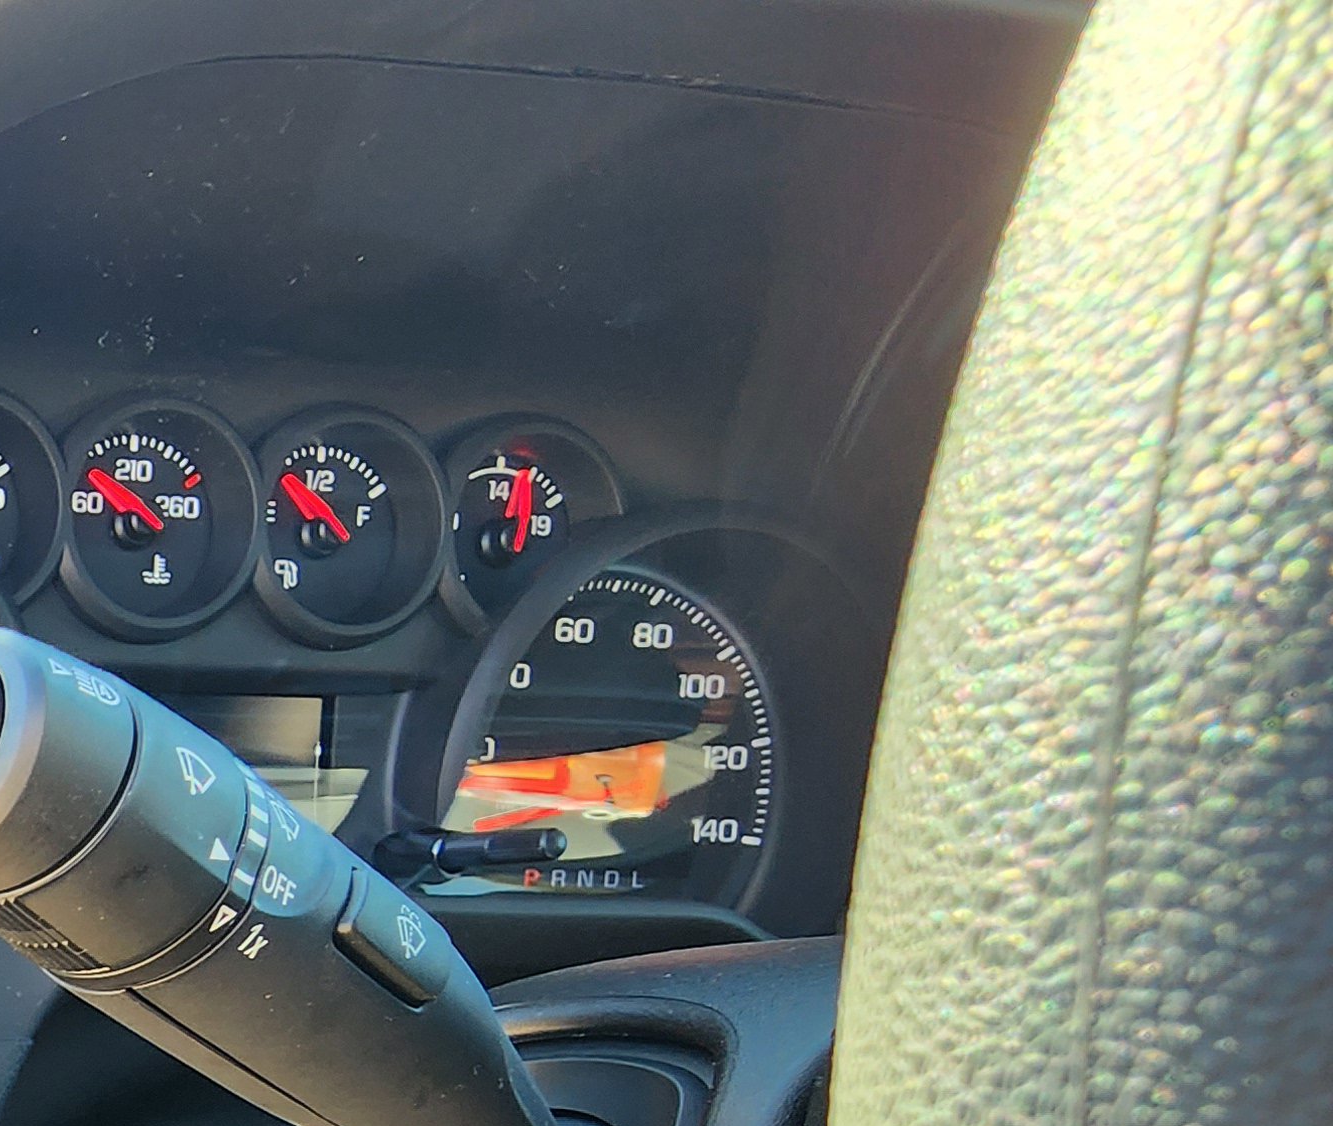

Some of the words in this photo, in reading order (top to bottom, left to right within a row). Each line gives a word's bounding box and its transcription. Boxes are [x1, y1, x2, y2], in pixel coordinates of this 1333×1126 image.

[114, 458, 153, 482] 210
[305, 469, 335, 492] 1/2
[71, 491, 104, 514] 60
[488, 480, 510, 501] 14
[356, 505, 371, 527] F
[530, 514, 552, 537] 19
[554, 617, 595, 644] 60
[632, 622, 673, 649] 80
[509, 663, 531, 689] 0
[678, 673, 726, 699] 100
[701, 745, 748, 770] 120
[691, 817, 739, 843] 140
[261, 865, 297, 906] OFF
[523, 868, 542, 887] P
[550, 869, 567, 888] R
[576, 870, 594, 888] N
[603, 870, 620, 888] D
[631, 870, 645, 889] L
[237, 923, 269, 960] 1x
